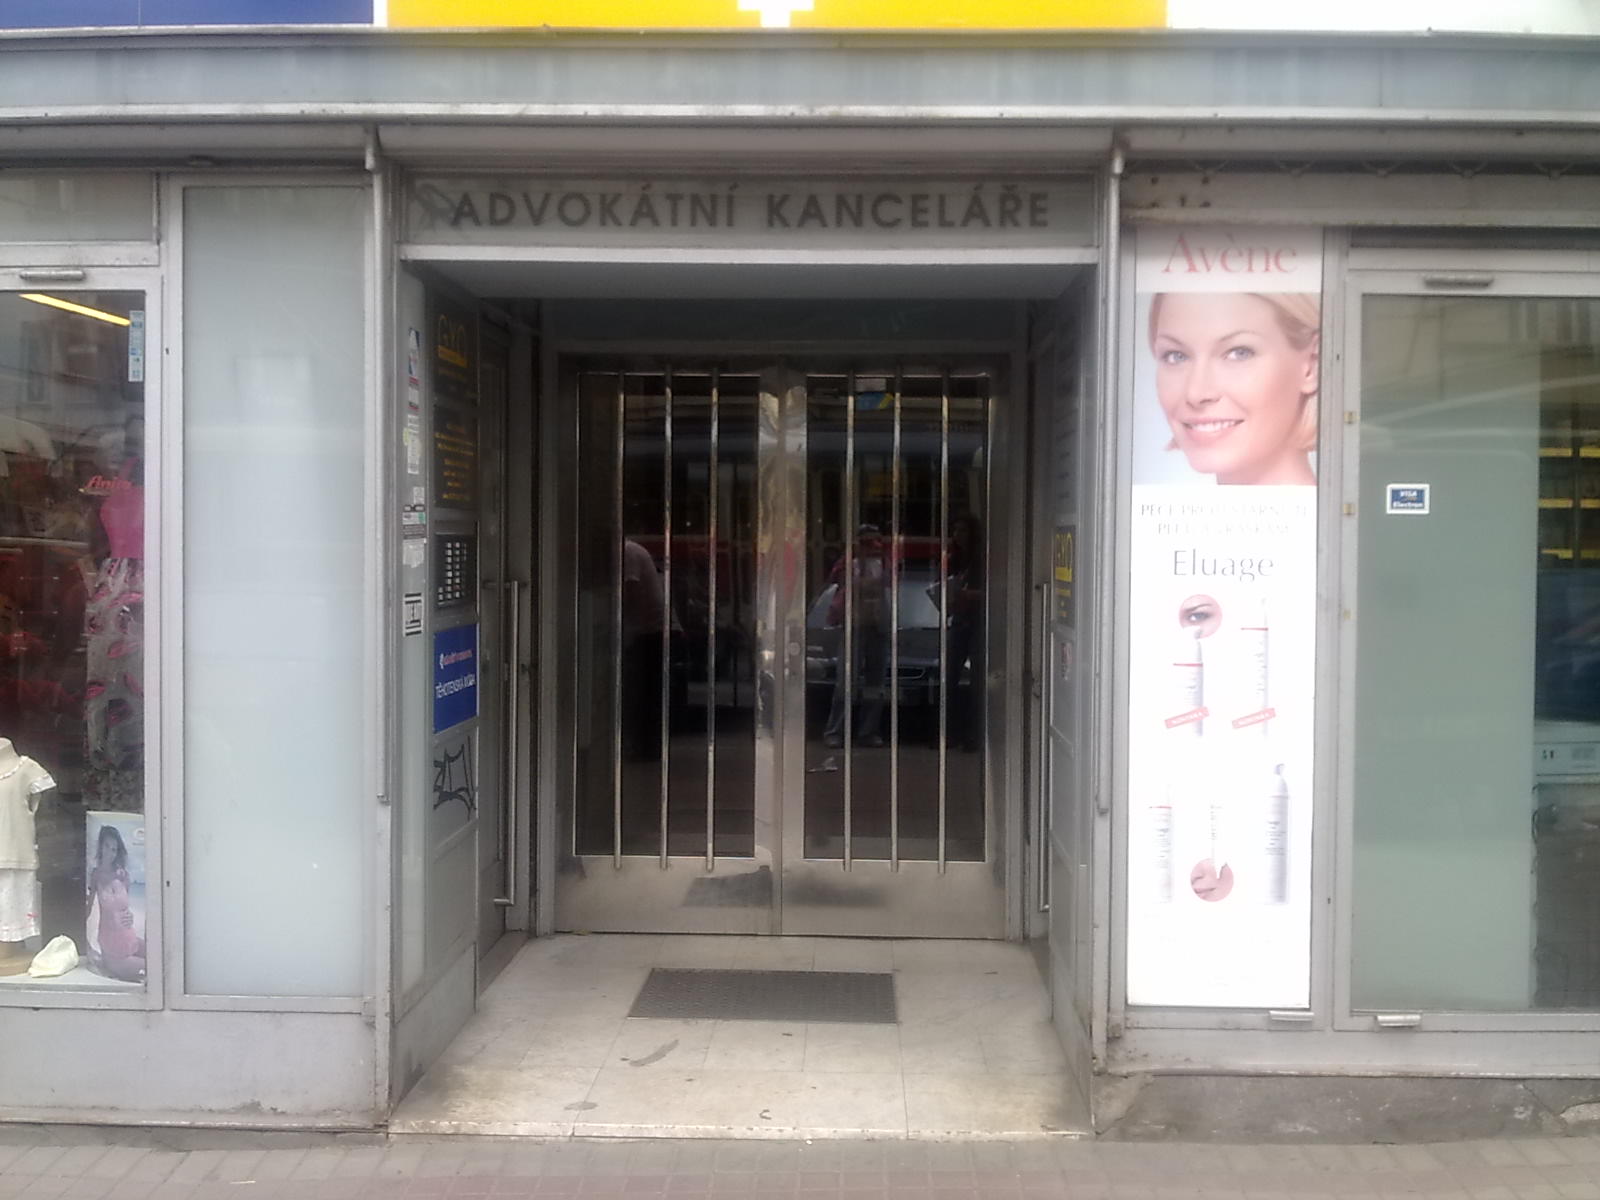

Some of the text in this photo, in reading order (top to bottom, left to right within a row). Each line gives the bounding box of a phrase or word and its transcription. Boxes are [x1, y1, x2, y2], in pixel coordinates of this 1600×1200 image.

[451, 183, 1049, 228] ADVOKÁTNÍ KANCELÁŘE
[1161, 232, 1298, 273] Avène
[1173, 548, 1274, 582] Eluage
